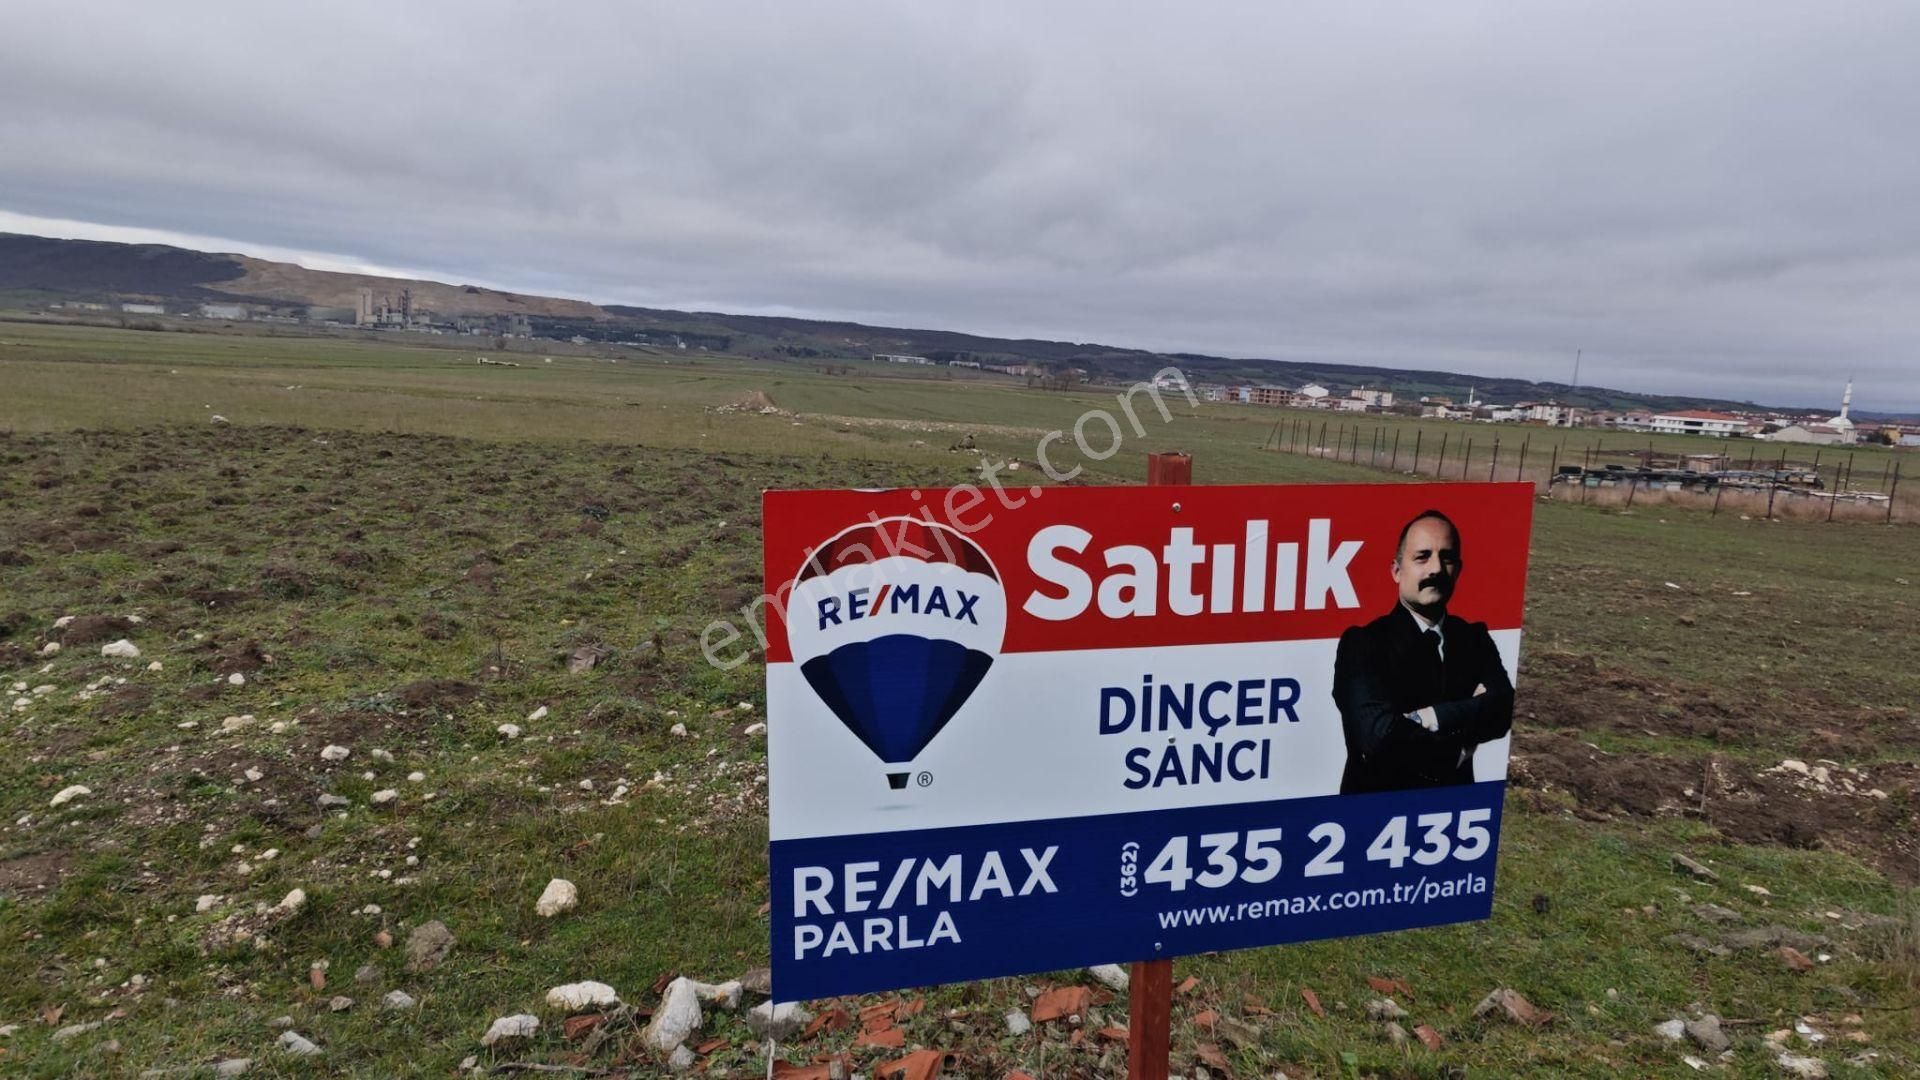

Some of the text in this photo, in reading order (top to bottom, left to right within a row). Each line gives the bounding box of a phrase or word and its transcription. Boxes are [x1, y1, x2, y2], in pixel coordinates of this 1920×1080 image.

[1023, 518, 1364, 621] Satılık
[817, 584, 980, 631] RE/MAX
[1099, 674, 1302, 737] DİNÇER
[1123, 739, 1270, 790] SANCI
[793, 845, 1059, 918] RE/MAX
[1120, 808, 1492, 897] (362) 435 2 435
[1158, 873, 1486, 929] www.remax.com.tr/parla
[794, 911, 962, 960] PARLA
